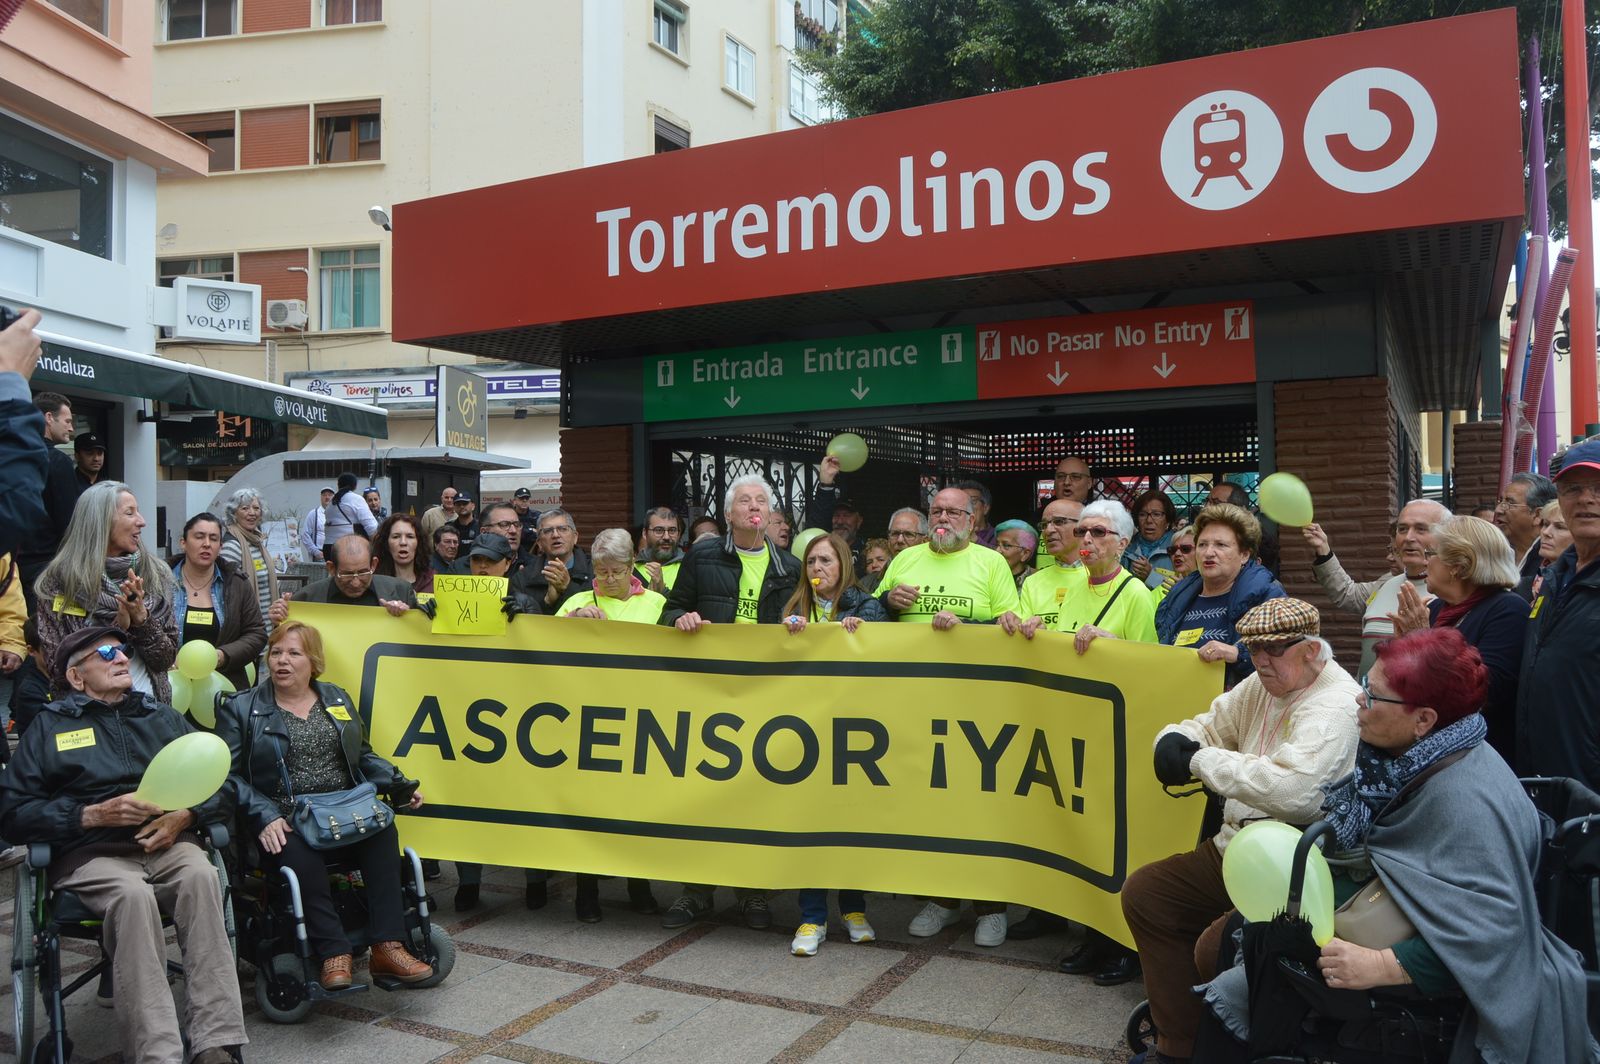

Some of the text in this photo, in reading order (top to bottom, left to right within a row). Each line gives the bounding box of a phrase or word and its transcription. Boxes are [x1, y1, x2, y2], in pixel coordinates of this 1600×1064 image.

[596, 150, 1111, 277] Torremolinos
[186, 314, 251, 333] VOLAPIÉ
[1010, 321, 1213, 357] No Pasar No Entry
[35, 354, 95, 379] Andaluza
[692, 344, 919, 383] Entrada Entrance
[285, 401, 328, 425] VOLAPIÉ
[447, 430, 486, 451] VOLTAGE
[436, 577, 505, 604] ASCENSOR
[456, 599, 479, 627] YA!
[392, 695, 1086, 815] ASCENSOR ¡YA!
